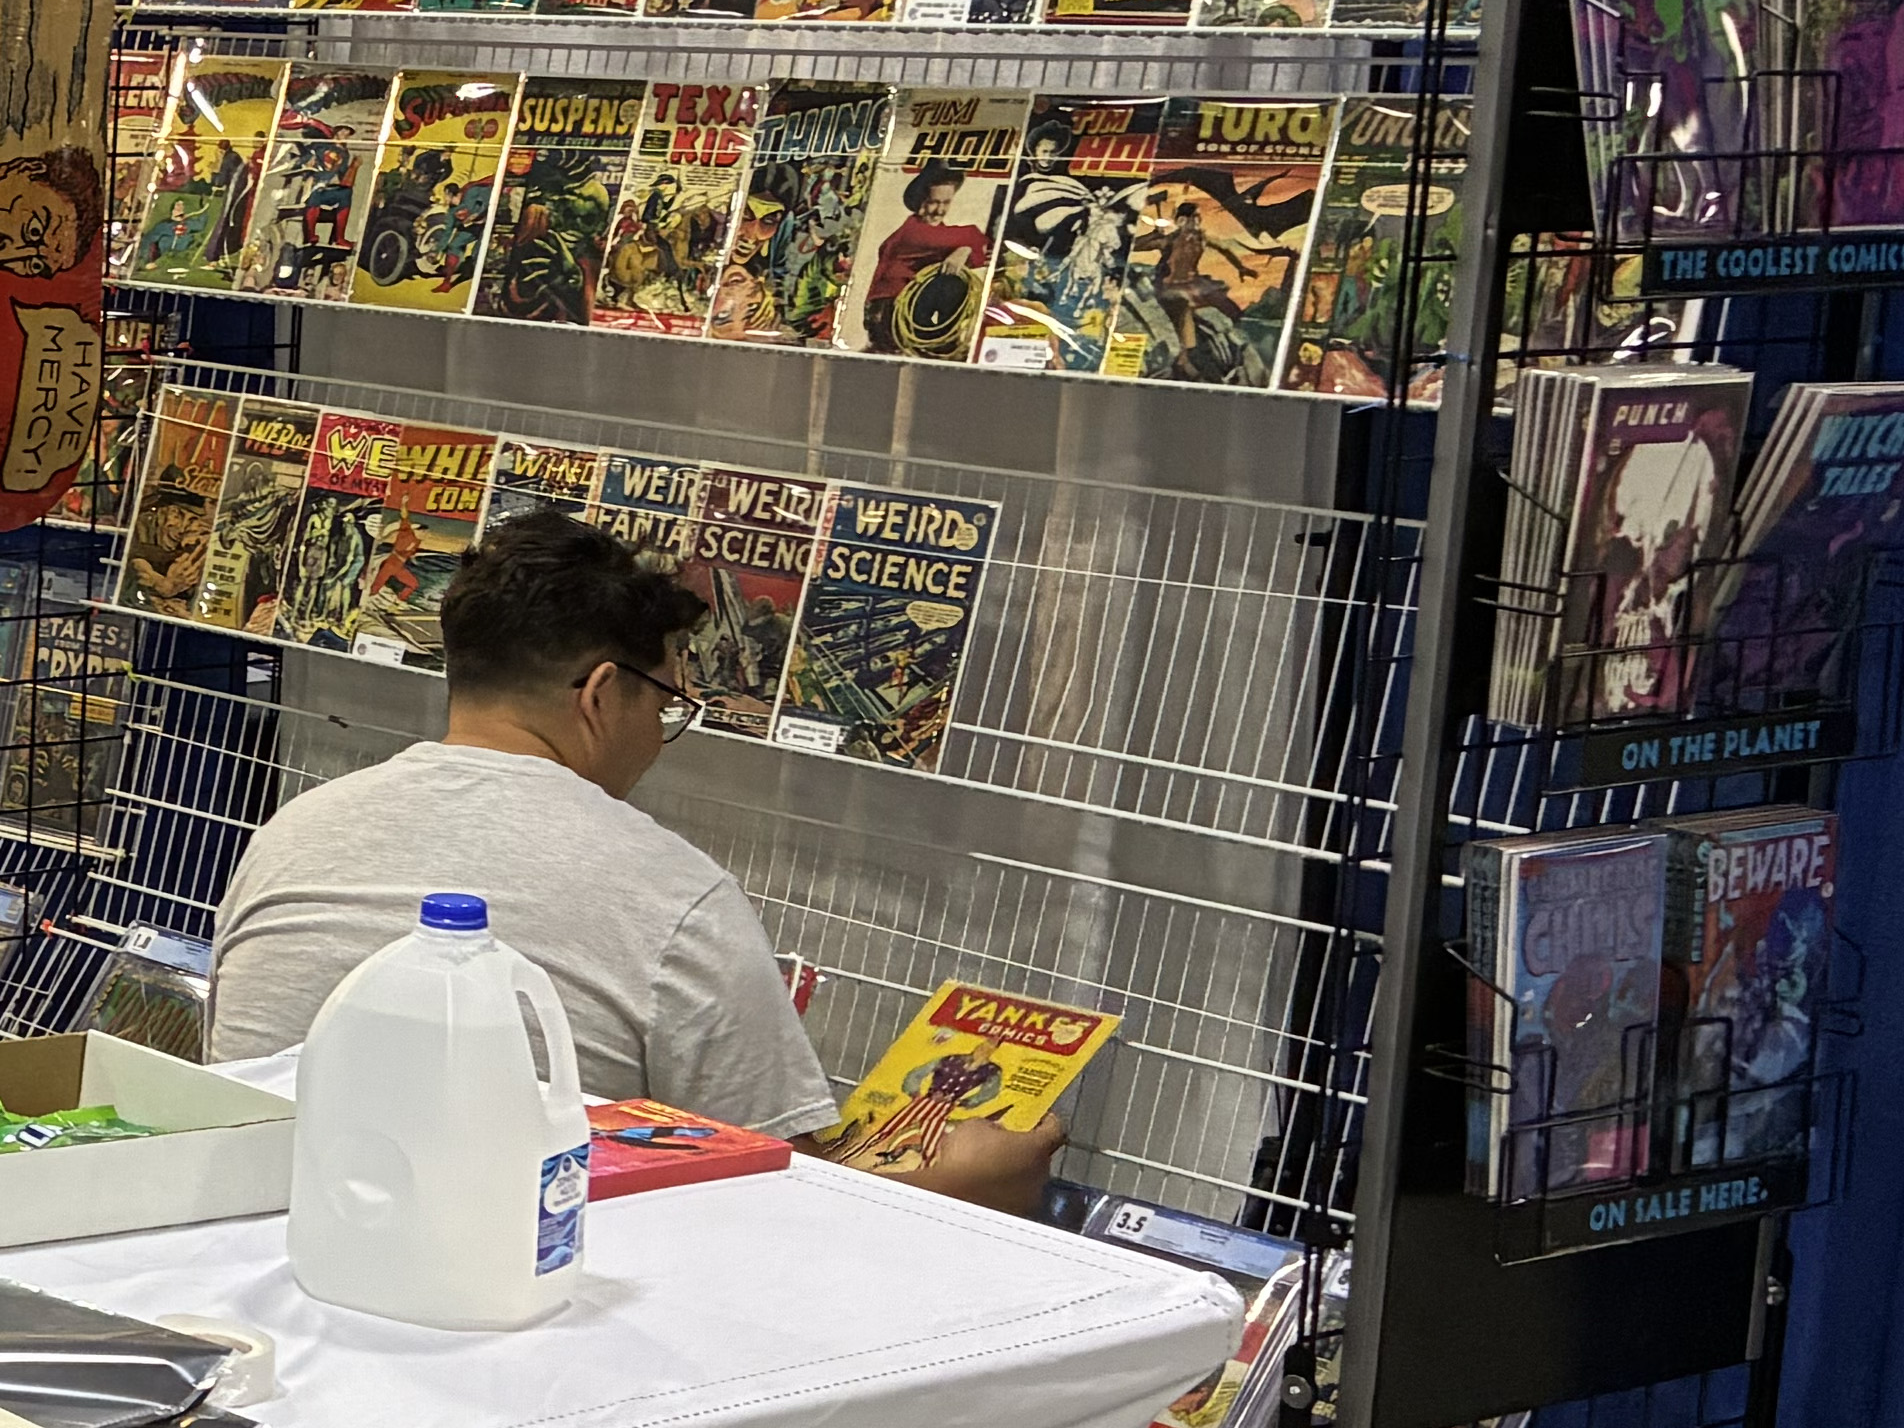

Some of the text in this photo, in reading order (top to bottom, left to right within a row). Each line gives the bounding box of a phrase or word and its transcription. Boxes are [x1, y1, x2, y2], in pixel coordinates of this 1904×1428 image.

[909, 100, 978, 127] TIM
[1072, 107, 1133, 133] TIM
[672, 129, 743, 165] KID
[1196, 142, 1325, 158] SON OF STONE
[1661, 249, 1708, 280] THE
[1717, 246, 1819, 279] COOLEST
[22, 325, 64, 475] MERCY!
[57, 341, 95, 452] HAVE
[1613, 401, 1688, 429] PUNCH
[1821, 466, 1892, 498] TALES
[850, 492, 962, 549] WEIRD
[826, 546, 974, 599] SCIENCE
[1623, 721, 1822, 771] ON THE PLANET
[1115, 1211, 1149, 1235] 3.5
[1589, 1200, 1626, 1232] ON
[1635, 1189, 1692, 1225] SALE
